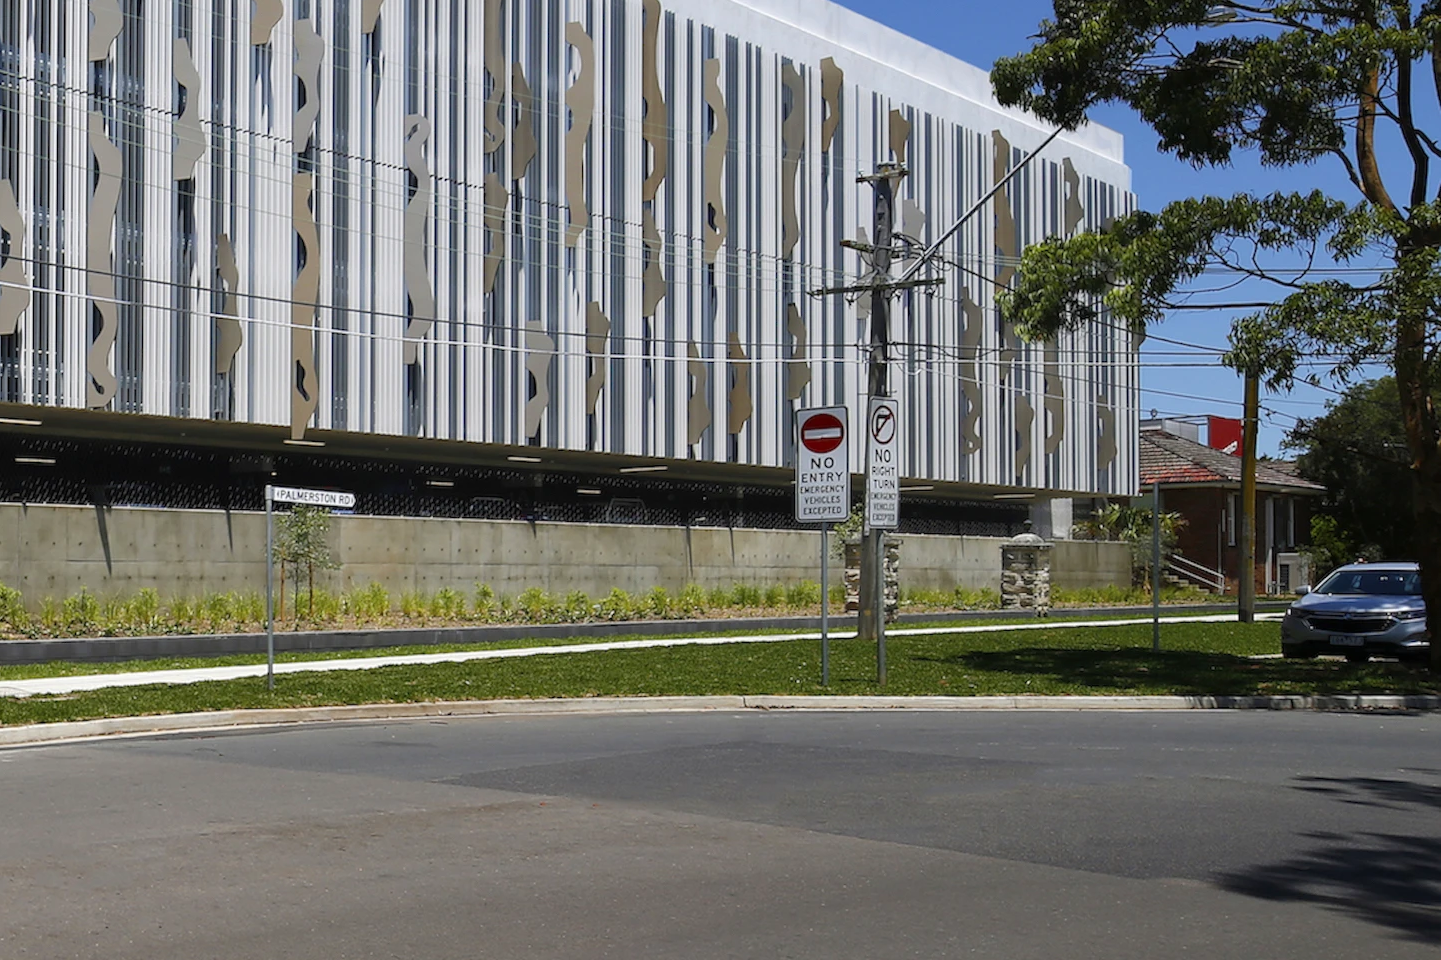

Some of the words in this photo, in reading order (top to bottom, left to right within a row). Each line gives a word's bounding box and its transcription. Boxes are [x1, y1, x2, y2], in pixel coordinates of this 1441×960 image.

[875, 449, 891, 463] NO
[810, 457, 834, 470] NO
[871, 467, 896, 476] RIGHT
[801, 472, 843, 484] ENTRY
[800, 484, 845, 494] EMERGENCY
[873, 480, 895, 489] TURN
[280, 489, 336, 505] PALMERSTON
[338, 495, 351, 506] RD
[804, 496, 840, 505] VEHICLES
[803, 507, 841, 516] EXCEPTED
